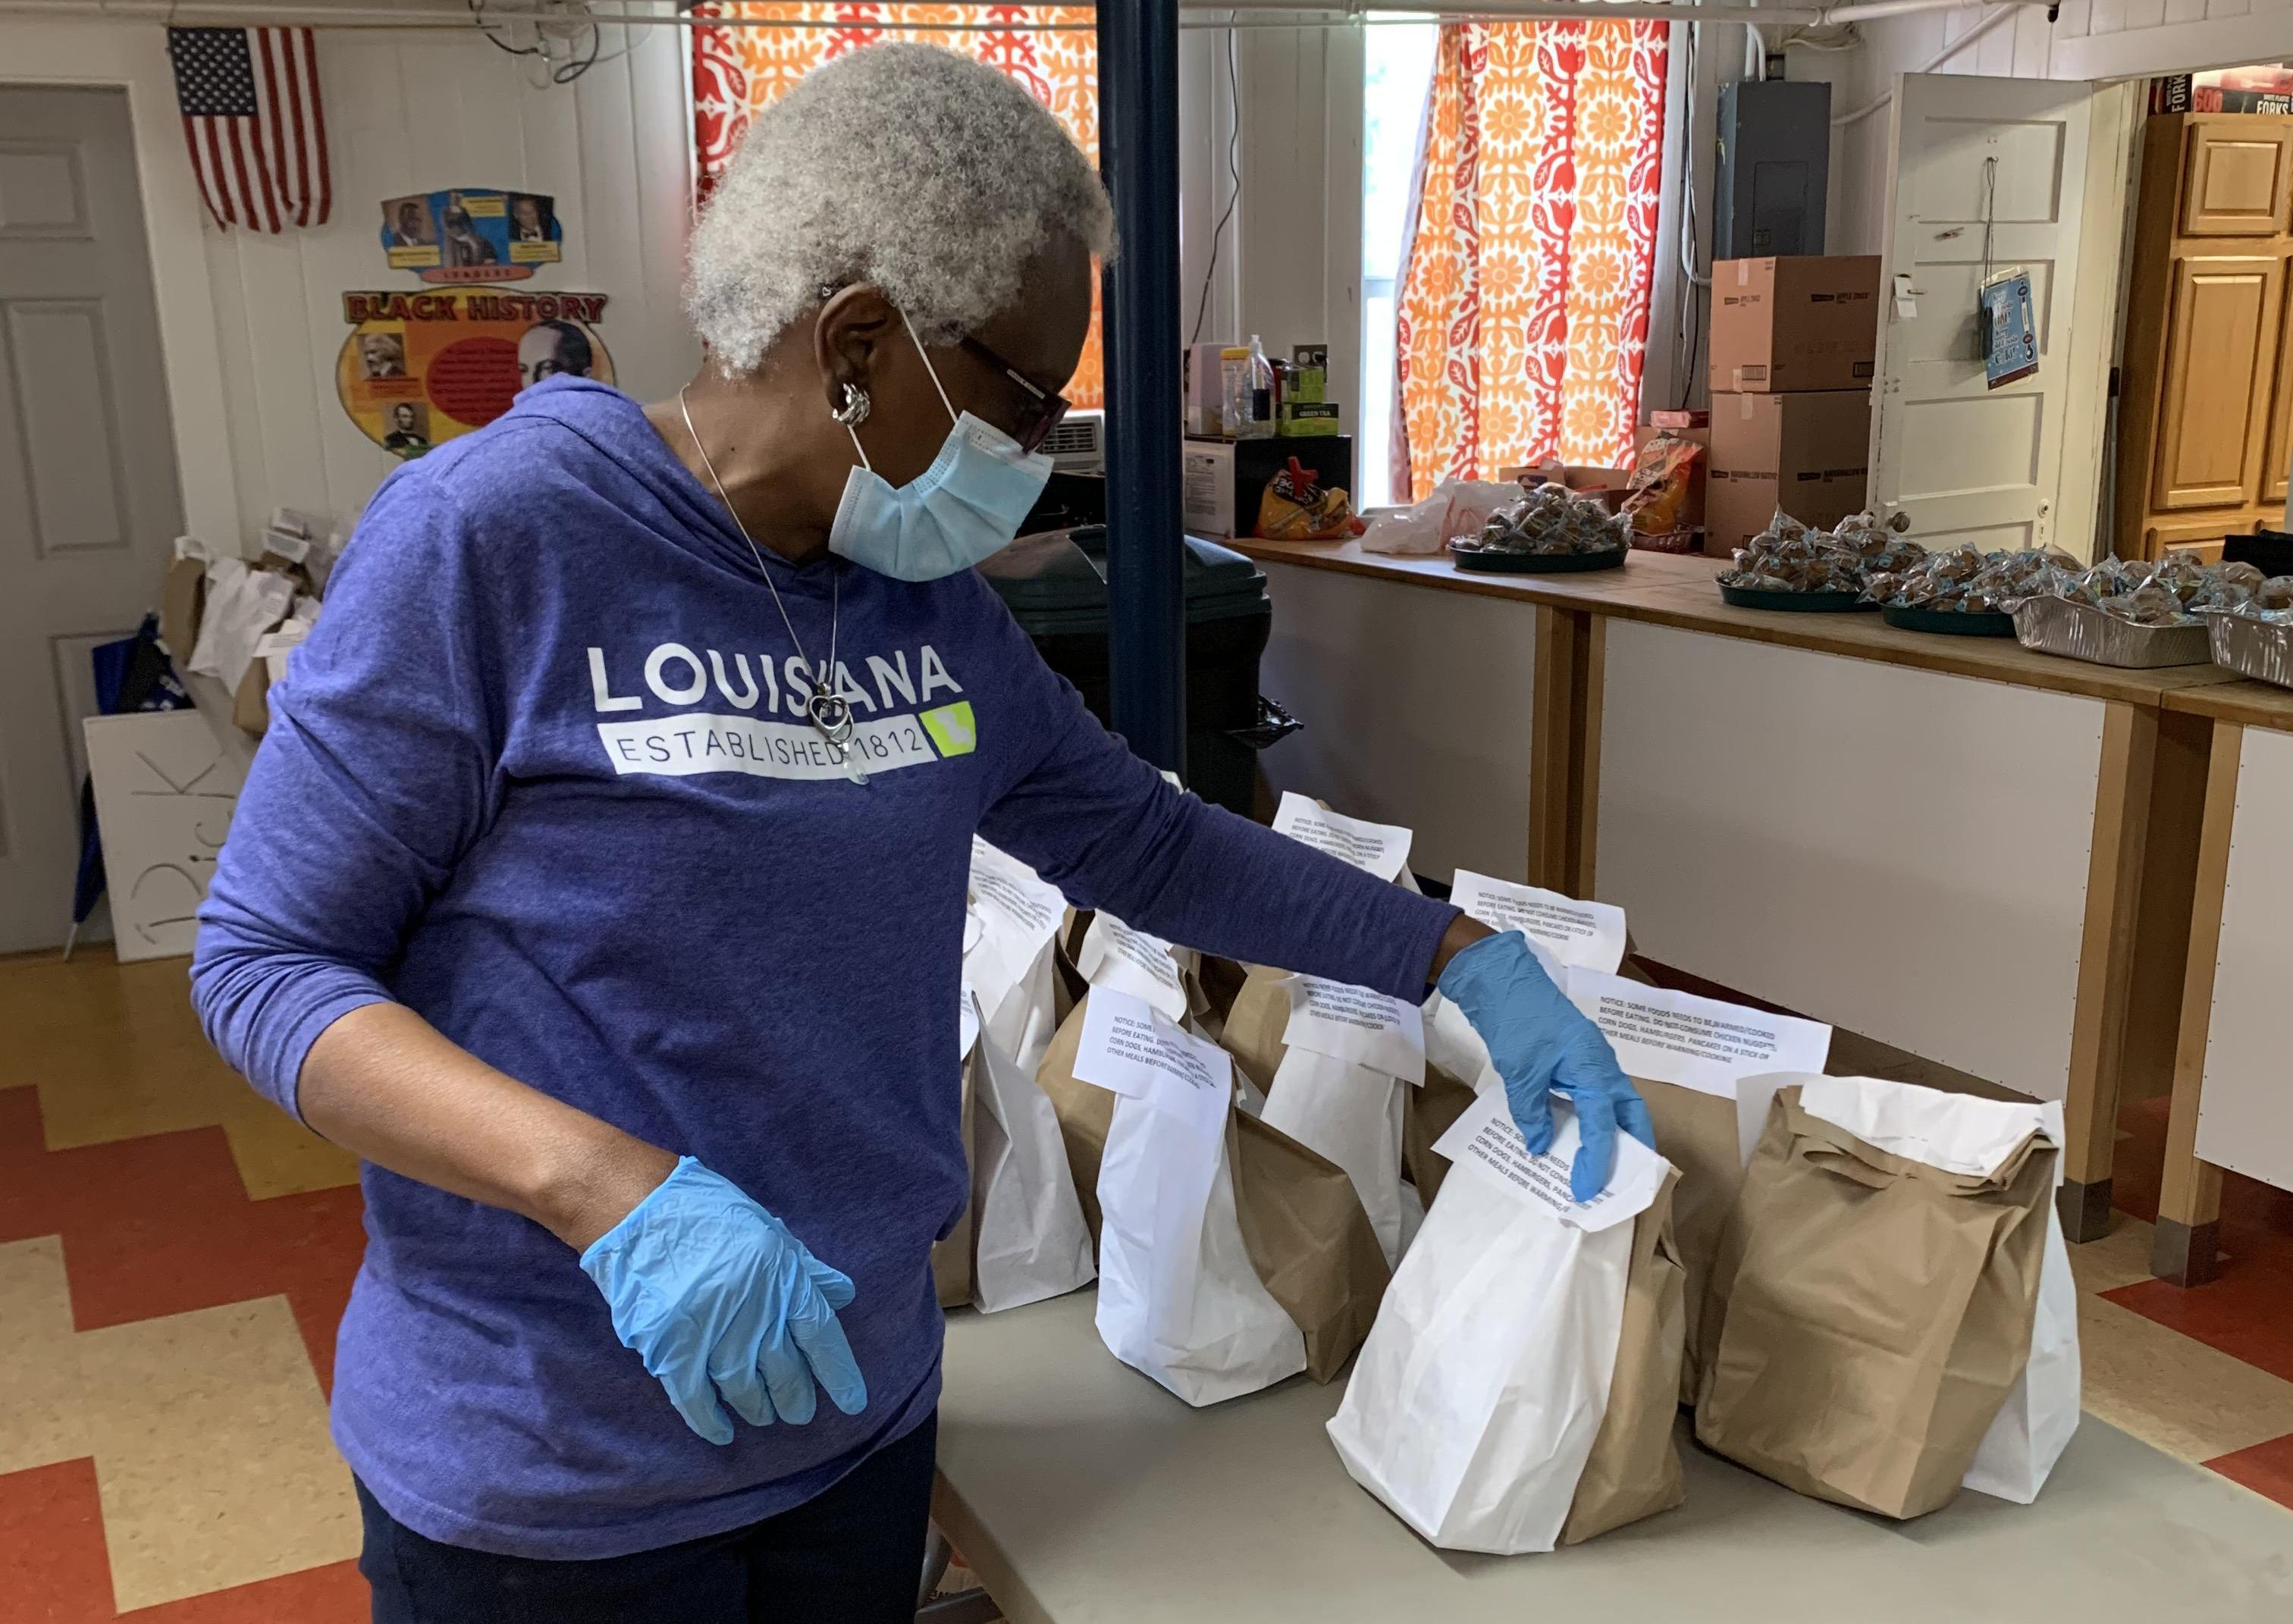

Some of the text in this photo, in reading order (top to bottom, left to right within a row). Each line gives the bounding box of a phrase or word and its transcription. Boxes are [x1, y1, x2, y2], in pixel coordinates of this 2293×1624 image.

[2172, 74, 2185, 113] FORK
[2194, 89, 2223, 112] 600
[2256, 100, 2288, 115] FORKS
[347, 294, 606, 323] BLACK HISTORY
[616, 728, 924, 766] ESTABLISHED 1812
[1598, 1017, 1617, 1026] CORN
[1599, 1007, 1623, 1017] BEFORE
[1627, 1002, 1647, 1012] SOME
[1672, 1012, 1692, 1022] NEEDS
[1112, 1027, 1132, 1037] BEFORE
[1137, 1022, 1153, 1031] SOME
[1601, 1029, 1617, 1038] THER
[1620, 1033, 1641, 1043] MEALS
[1642, 1037, 1667, 1049] BEFORE
[1107, 1048, 1125, 1056] OTHER
[1125, 1052, 1143, 1062] MEALS
[1482, 1127, 1505, 1145] BEFORE
[1538, 1162, 1550, 1173] NOT
[1514, 1131, 1526, 1144] SO
[1550, 1155, 1570, 1171] NEEDS
[1467, 1144, 1488, 1161] OTHER
[1488, 1157, 1509, 1175] MEALS
[1508, 1171, 1530, 1189] BEFORE
[1476, 1135, 1493, 1149] CORN
[1553, 1186, 1575, 1202] PANC
